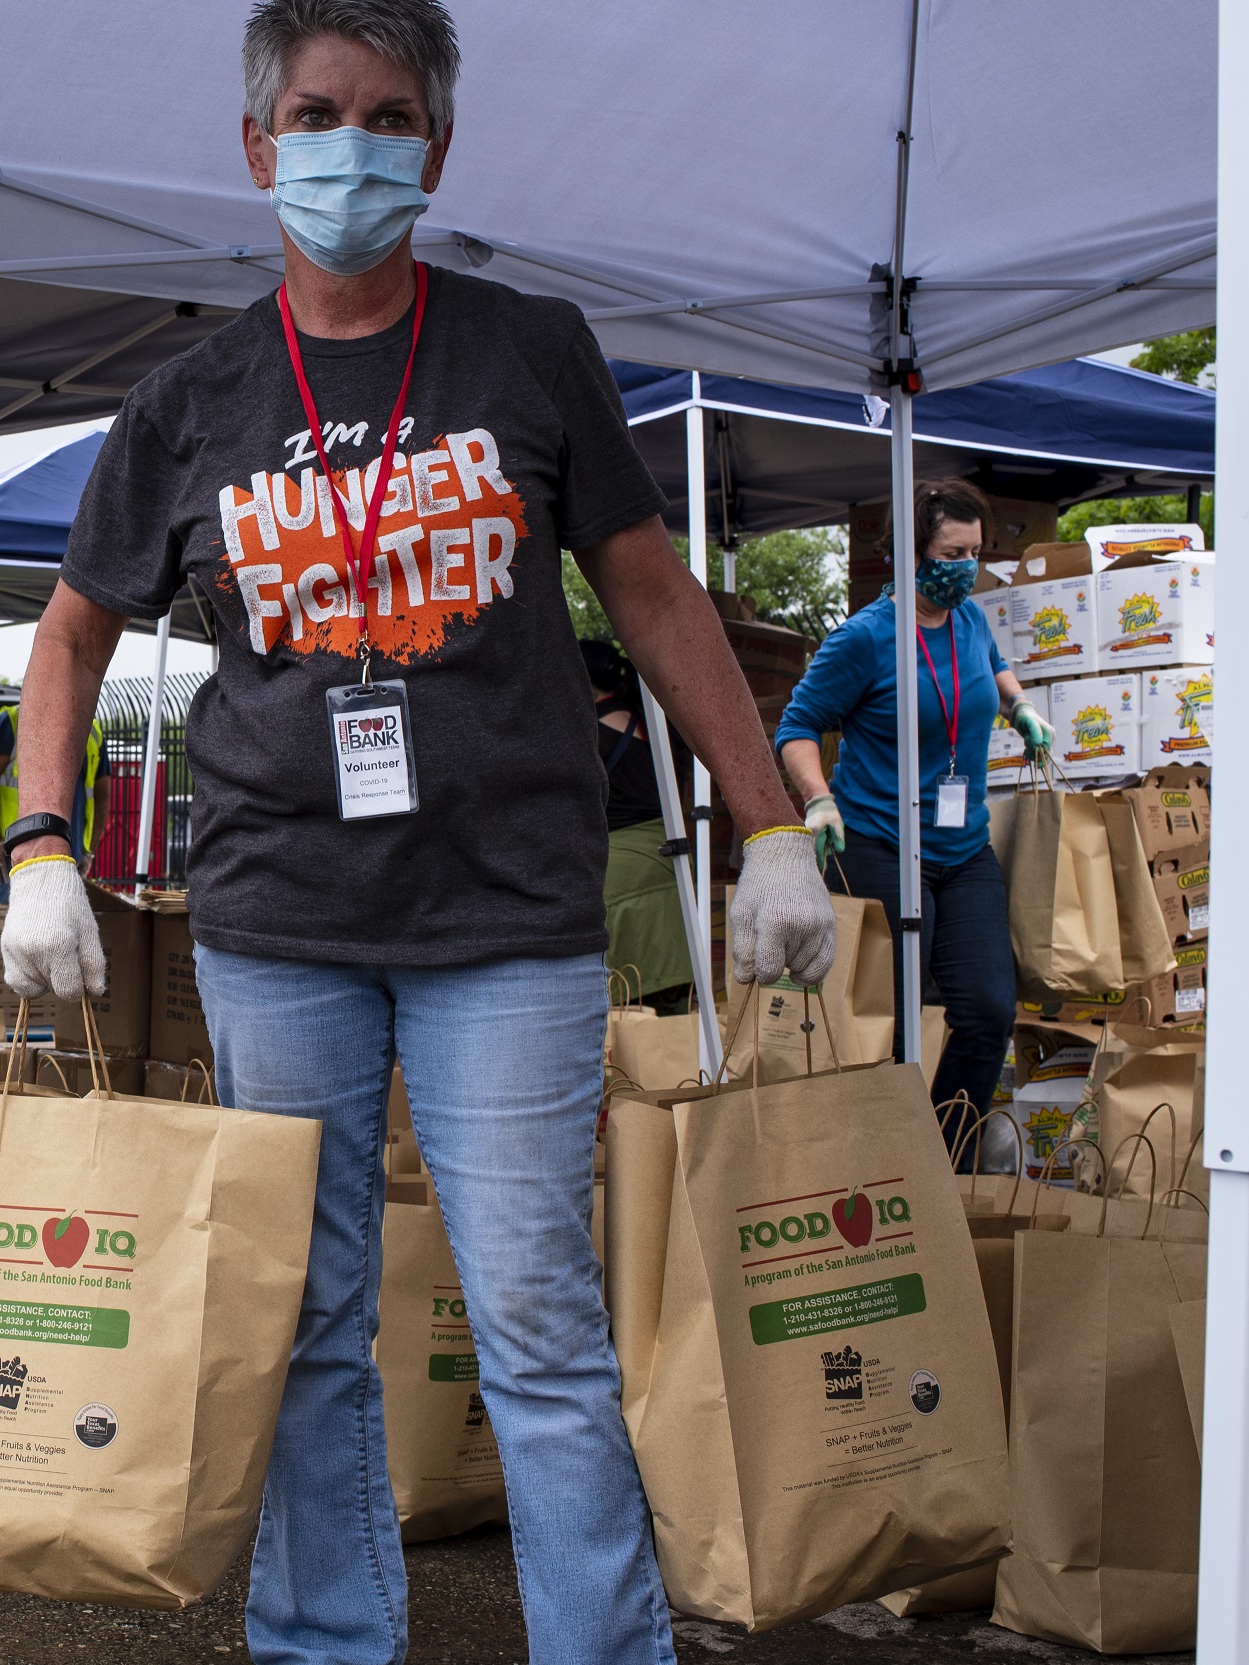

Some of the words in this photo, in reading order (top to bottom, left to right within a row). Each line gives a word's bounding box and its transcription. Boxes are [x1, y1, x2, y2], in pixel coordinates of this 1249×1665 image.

[284, 421, 369, 470] I'M
[219, 428, 512, 563] HUNGER
[237, 516, 516, 655] FIGHTER
[1075, 716, 1110, 744] Fresh
[350, 730, 399, 750] BANK
[345, 760, 400, 773] Volunteer
[360, 778, 388, 786] COVID-19
[345, 792, 360, 801] Crisis
[362, 790, 389, 800] Response
[390, 789, 406, 797] Team
[738, 1211, 831, 1254] FOOD
[875, 1196, 912, 1226] IQ
[95, 1228, 137, 1260] IQ
[745, 1275, 750, 1287] A
[751, 1267, 792, 1288] program
[794, 1264, 805, 1277] of
[806, 1262, 824, 1275] the
[826, 1258, 844, 1271] San
[845, 1251, 876, 1267] Antonio
[876, 1247, 894, 1261] Food
[895, 1242, 917, 1256] Bank
[3, 1269, 19, 1282] the
[21, 1270, 38, 1283] San
[40, 1272, 77, 1286] Antonio
[79, 1275, 103, 1288] Food
[105, 1277, 132, 1291] Bank
[783, 1301, 802, 1313] FOR
[804, 1290, 861, 1309] ASSISTANCE,
[862, 1283, 894, 1298] CONTACT:
[48, 1308, 92, 1320] CONTACT:
[783, 1306, 843, 1326] 1-210-431-8326
[845, 1305, 853, 1314] or
[854, 1295, 898, 1312] 1-800-246-9121
[36, 1319, 93, 1331] 1-800-246-9121
[787, 1307, 899, 1336] www.safoodbank.org/need-help/
[431, 1332, 437, 1340] A
[438, 1332, 469, 1343] program
[863, 1358, 881, 1368] USDA
[28, 1375, 47, 1384] USDA
[825, 1374, 863, 1394] SNAP
[26, 1387, 64, 1395] Supplemental
[26, 1393, 50, 1401] Nutrition
[24, 1407, 47, 1415] Program
[25, 1400, 54, 1408] Assistance
[466, 1409, 486, 1421] SNAP
[826, 1434, 850, 1448] SNAP
[859, 1429, 881, 1441] Fruits
[882, 1427, 887, 1435] &
[888, 1421, 913, 1434] Veggies
[1, 1439, 24, 1451] Fruits
[26, 1443, 32, 1451] &
[34, 1443, 66, 1455] Veggies
[852, 1444, 875, 1455] Better
[876, 1436, 903, 1450] Nutrition
[15, 1453, 49, 1465] Nutrition
[18, 1488, 43, 1496] opportunity
[46, 1482, 71, 1490] Assistance
[72, 1485, 93, 1493] Program
